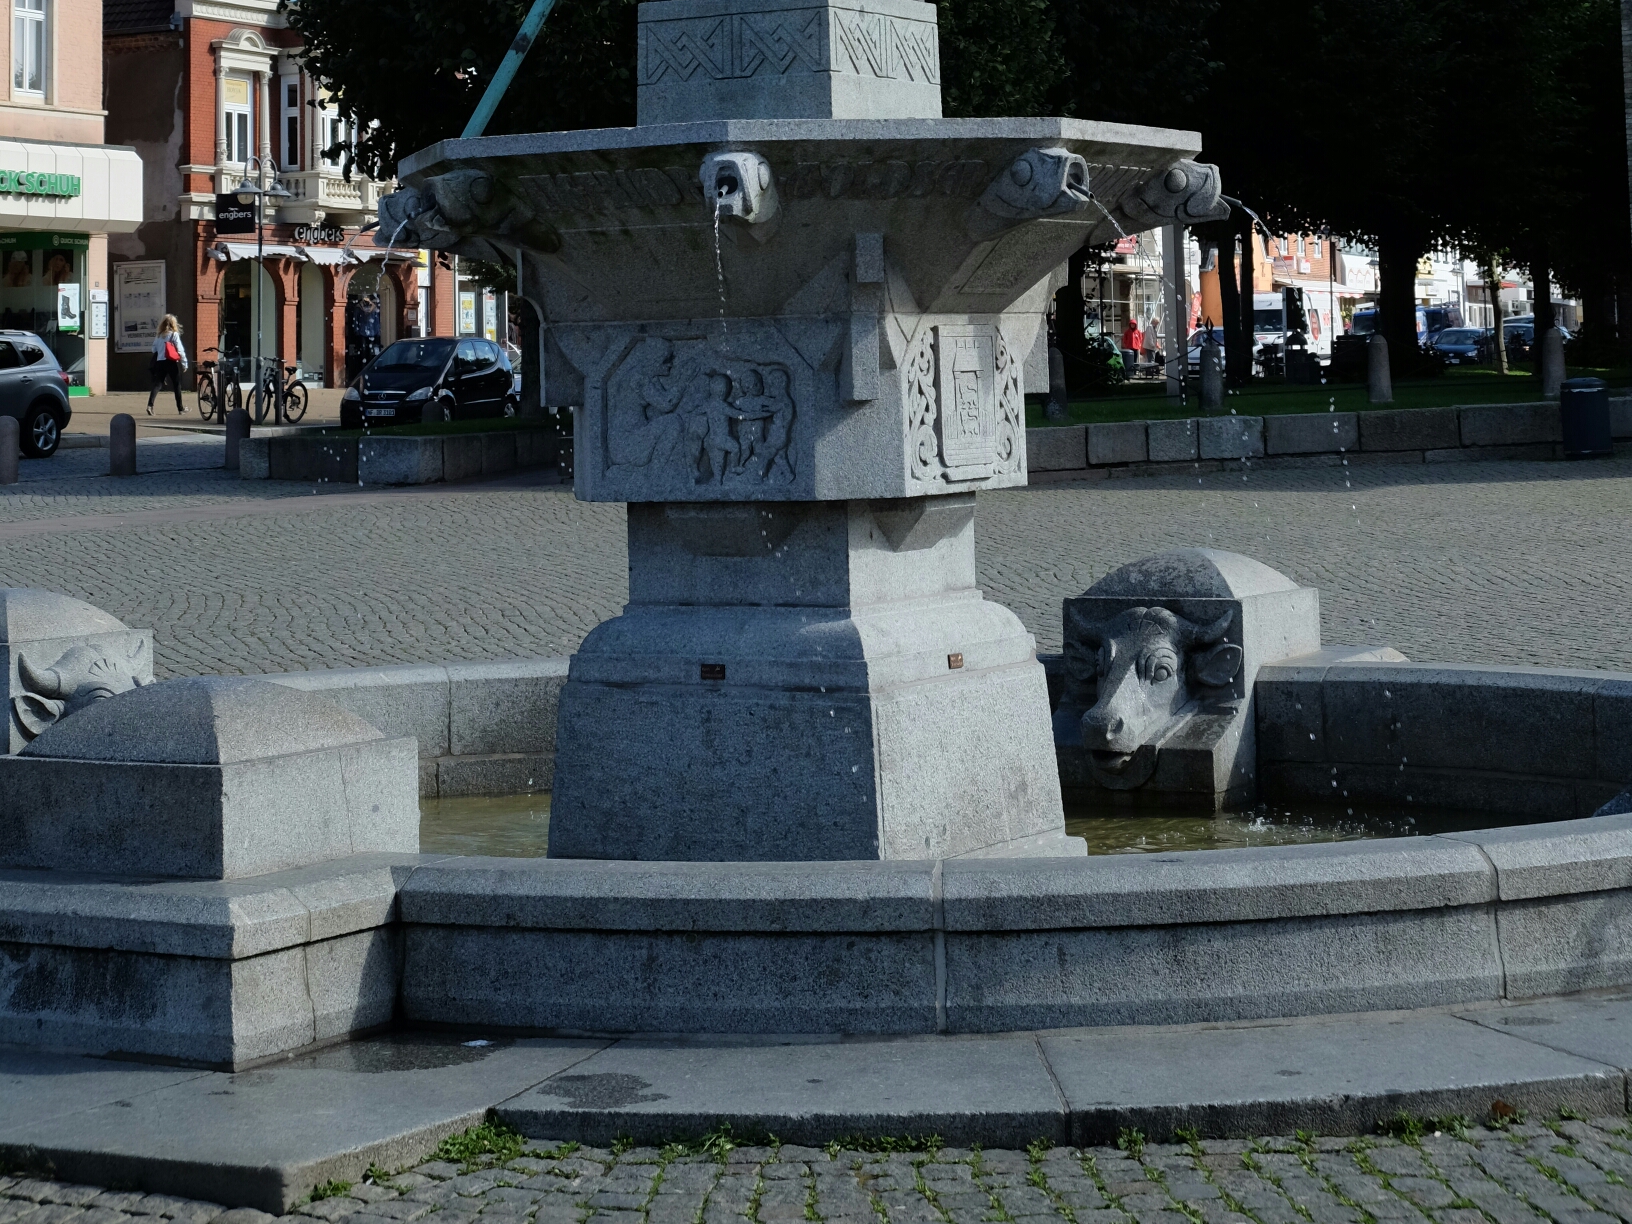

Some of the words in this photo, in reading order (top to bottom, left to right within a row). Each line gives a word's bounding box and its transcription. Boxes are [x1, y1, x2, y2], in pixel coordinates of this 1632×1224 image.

[25, 172, 81, 196] SCHUH
[219, 210, 252, 220] engbers
[294, 226, 344, 244] engbers
